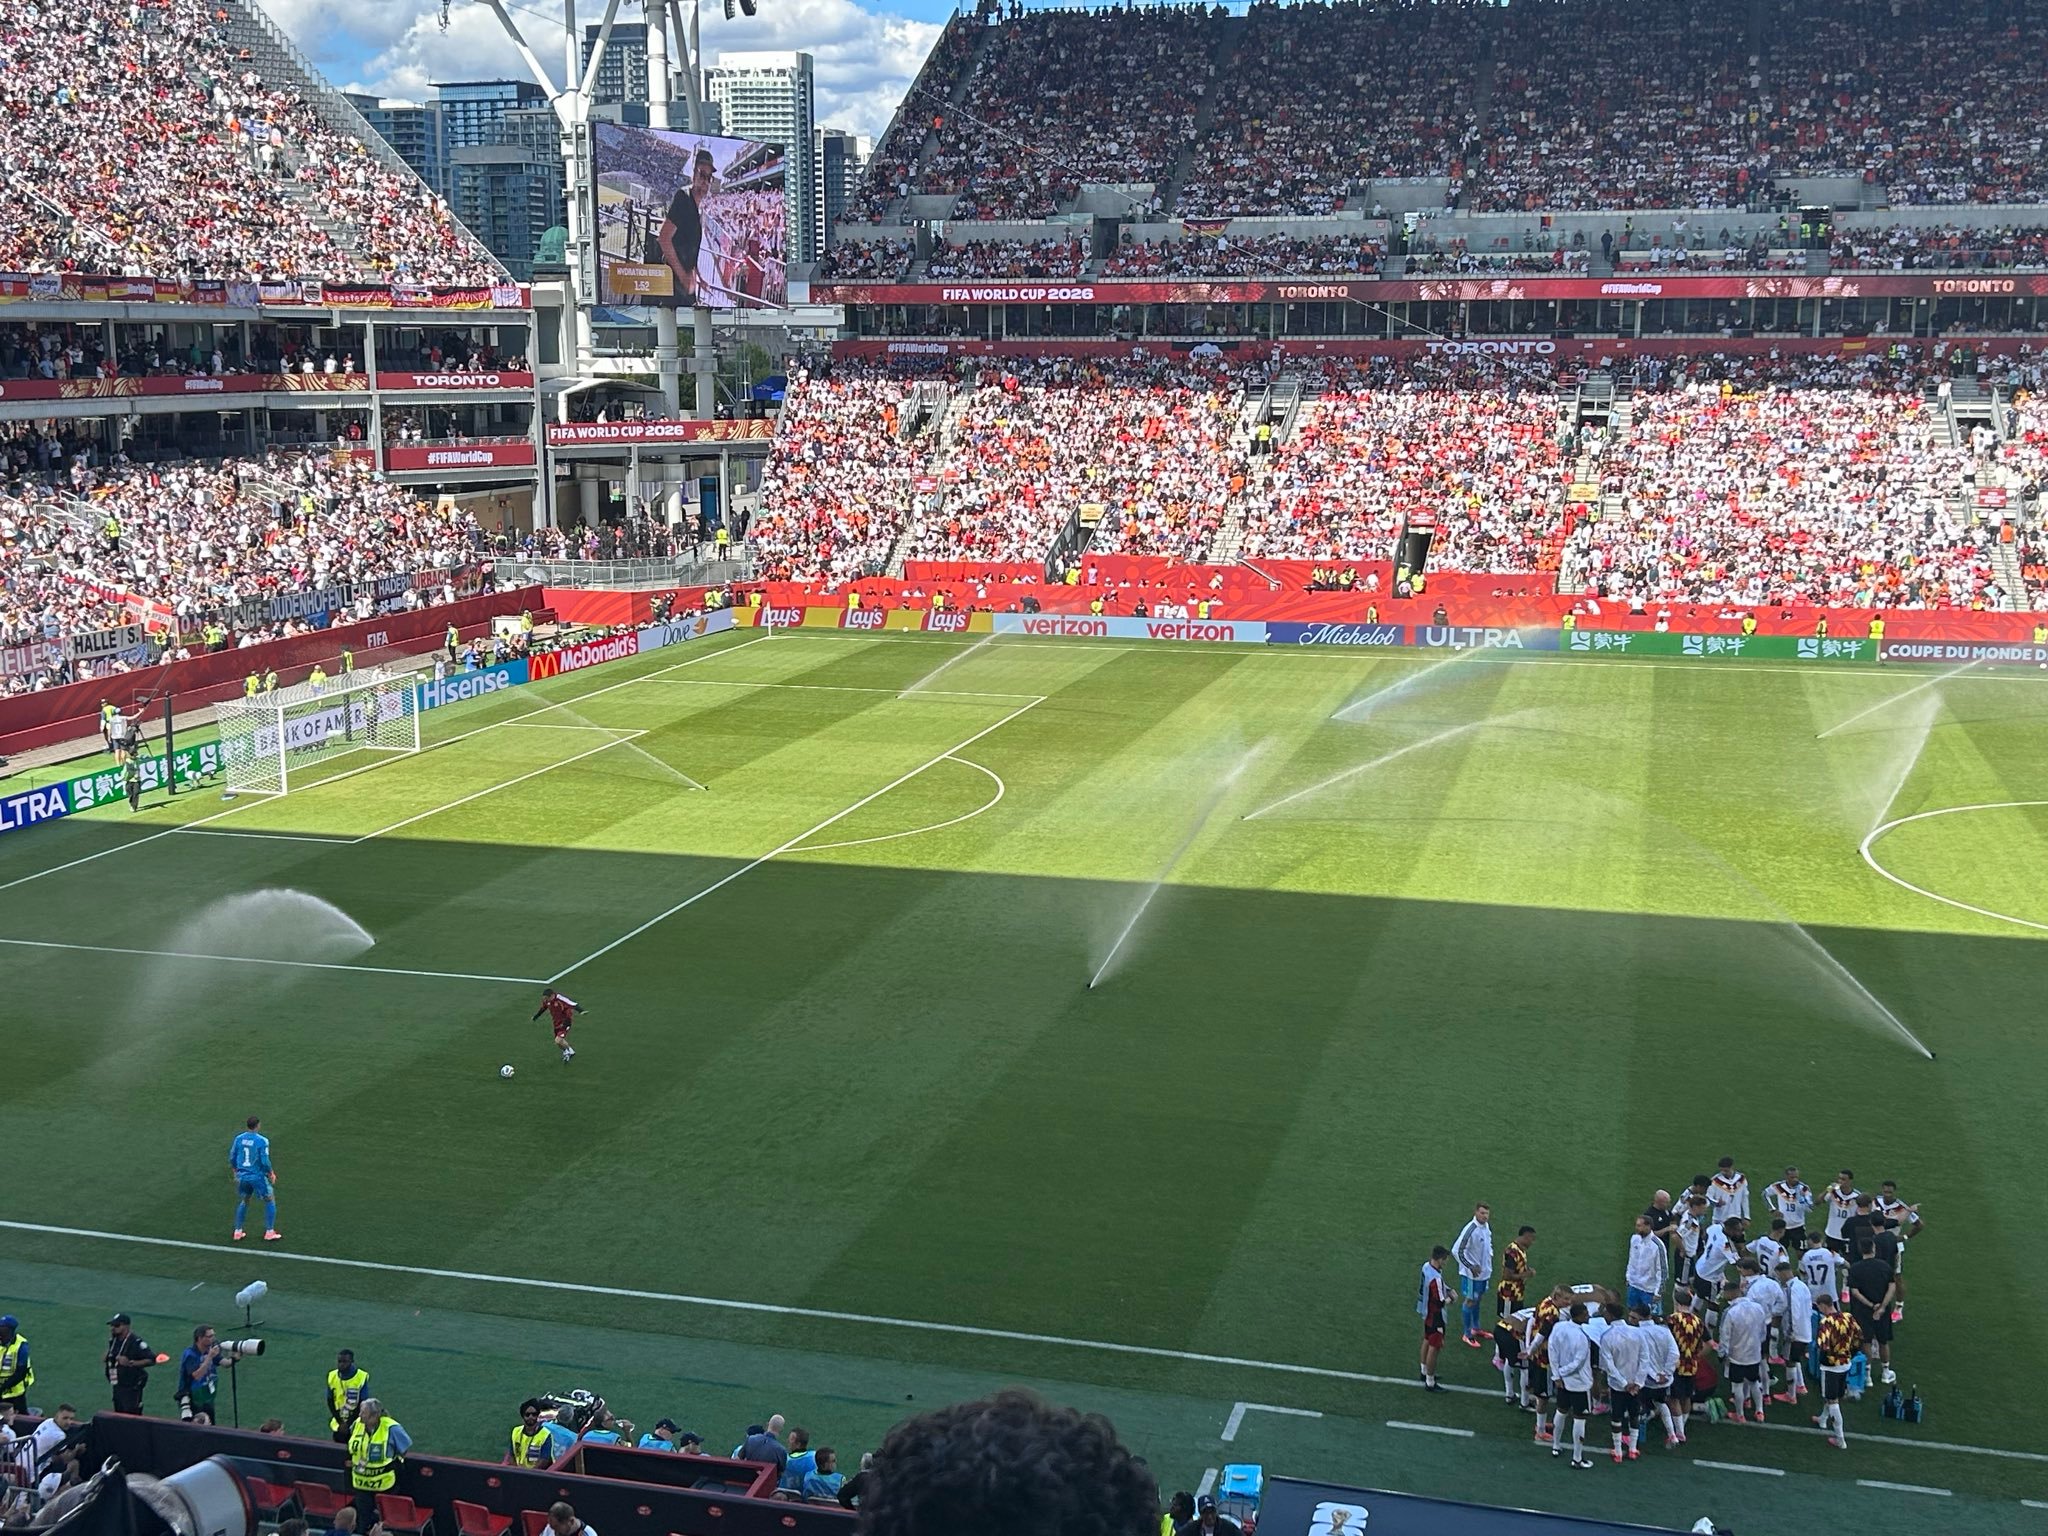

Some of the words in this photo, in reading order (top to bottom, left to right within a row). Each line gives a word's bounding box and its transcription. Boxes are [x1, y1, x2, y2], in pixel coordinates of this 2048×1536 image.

[943, 289, 970, 300] FIFA
[971, 288, 1019, 300] WORLD
[1021, 288, 1046, 300] CUP
[1048, 288, 1094, 300] 2026
[1278, 286, 1349, 298] TORONTO
[1601, 283, 1662, 295] #FIFAWorldCup
[1933, 279, 2015, 293] TORONTO
[888, 343, 948, 355] #FIFAWorldCup
[1426, 341, 1556, 354] TORONTO
[413, 375, 500, 386] TORONTO
[550, 427, 576, 440] FIFA
[577, 426, 620, 439] WORLD
[621, 426, 644, 438] CUP
[645, 425, 685, 437] 2026
[427, 450, 494, 465] #FIFAWorldCup
[270, 588, 343, 621] DUDENHOFEN
[761, 606, 800, 627] Lay's
[845, 607, 883, 629] Lay's
[928, 609, 966, 632] Lay's
[1022, 616, 1107, 636] verizon
[366, 631, 389, 648] FIFA
[663, 622, 690, 647] Dove
[1146, 619, 1234, 641] verizon
[1299, 621, 1396, 646] Michelob
[1425, 626, 1524, 649] ULTRA
[74, 630, 117, 655] HALLE
[127, 626, 139, 645] S.
[1594, 633, 1632, 652] 蒙牛
[1706, 636, 1745, 656] 蒙牛
[1822, 639, 1861, 659] 蒙牛
[560, 633, 638, 673] McDonald's
[1888, 644, 1943, 658] COUPE
[1945, 646, 1969, 659] DU
[1972, 646, 2033, 661] MONDE
[423, 668, 510, 710] Hisense
[304, 718, 321, 738] OF
[242, 1147, 251, 1167] 1
[1785, 1203, 1796, 1212] 19
[1837, 1209, 1847, 1218] 10
[1759, 1253, 1769, 1275] 5
[1807, 1264, 1829, 1286] 17
